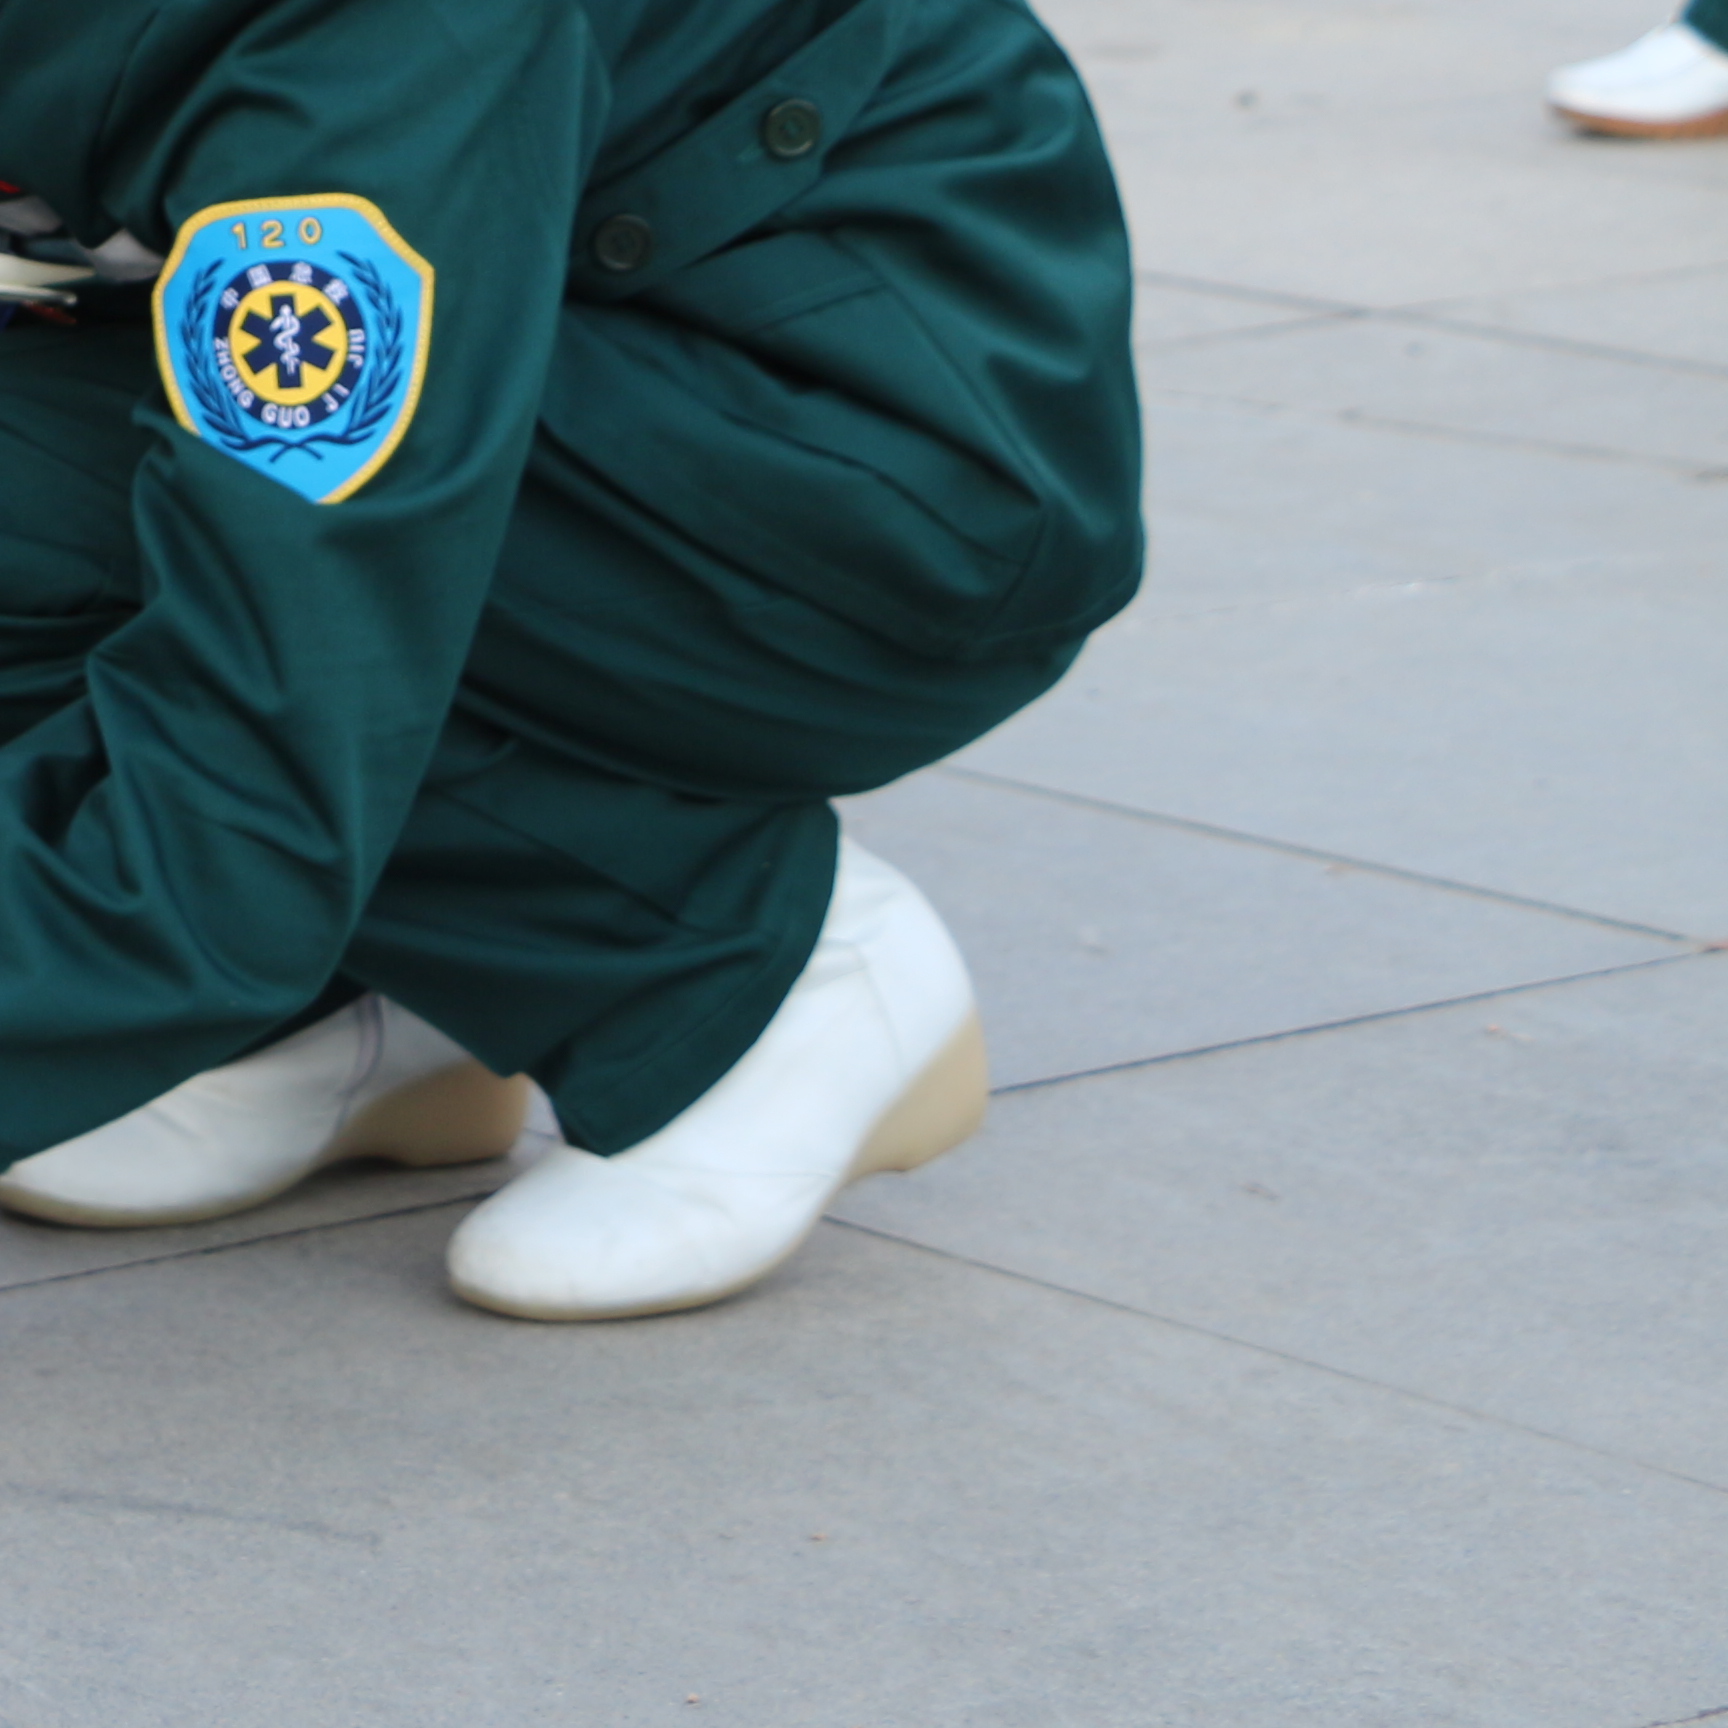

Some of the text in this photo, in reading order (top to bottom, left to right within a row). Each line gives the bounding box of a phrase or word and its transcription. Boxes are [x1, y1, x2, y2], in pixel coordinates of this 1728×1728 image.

[231, 216, 323, 249] 120
[213, 336, 255, 409] ZHONG
[260, 402, 311, 429] GUO
[348, 328, 366, 369] JIU
